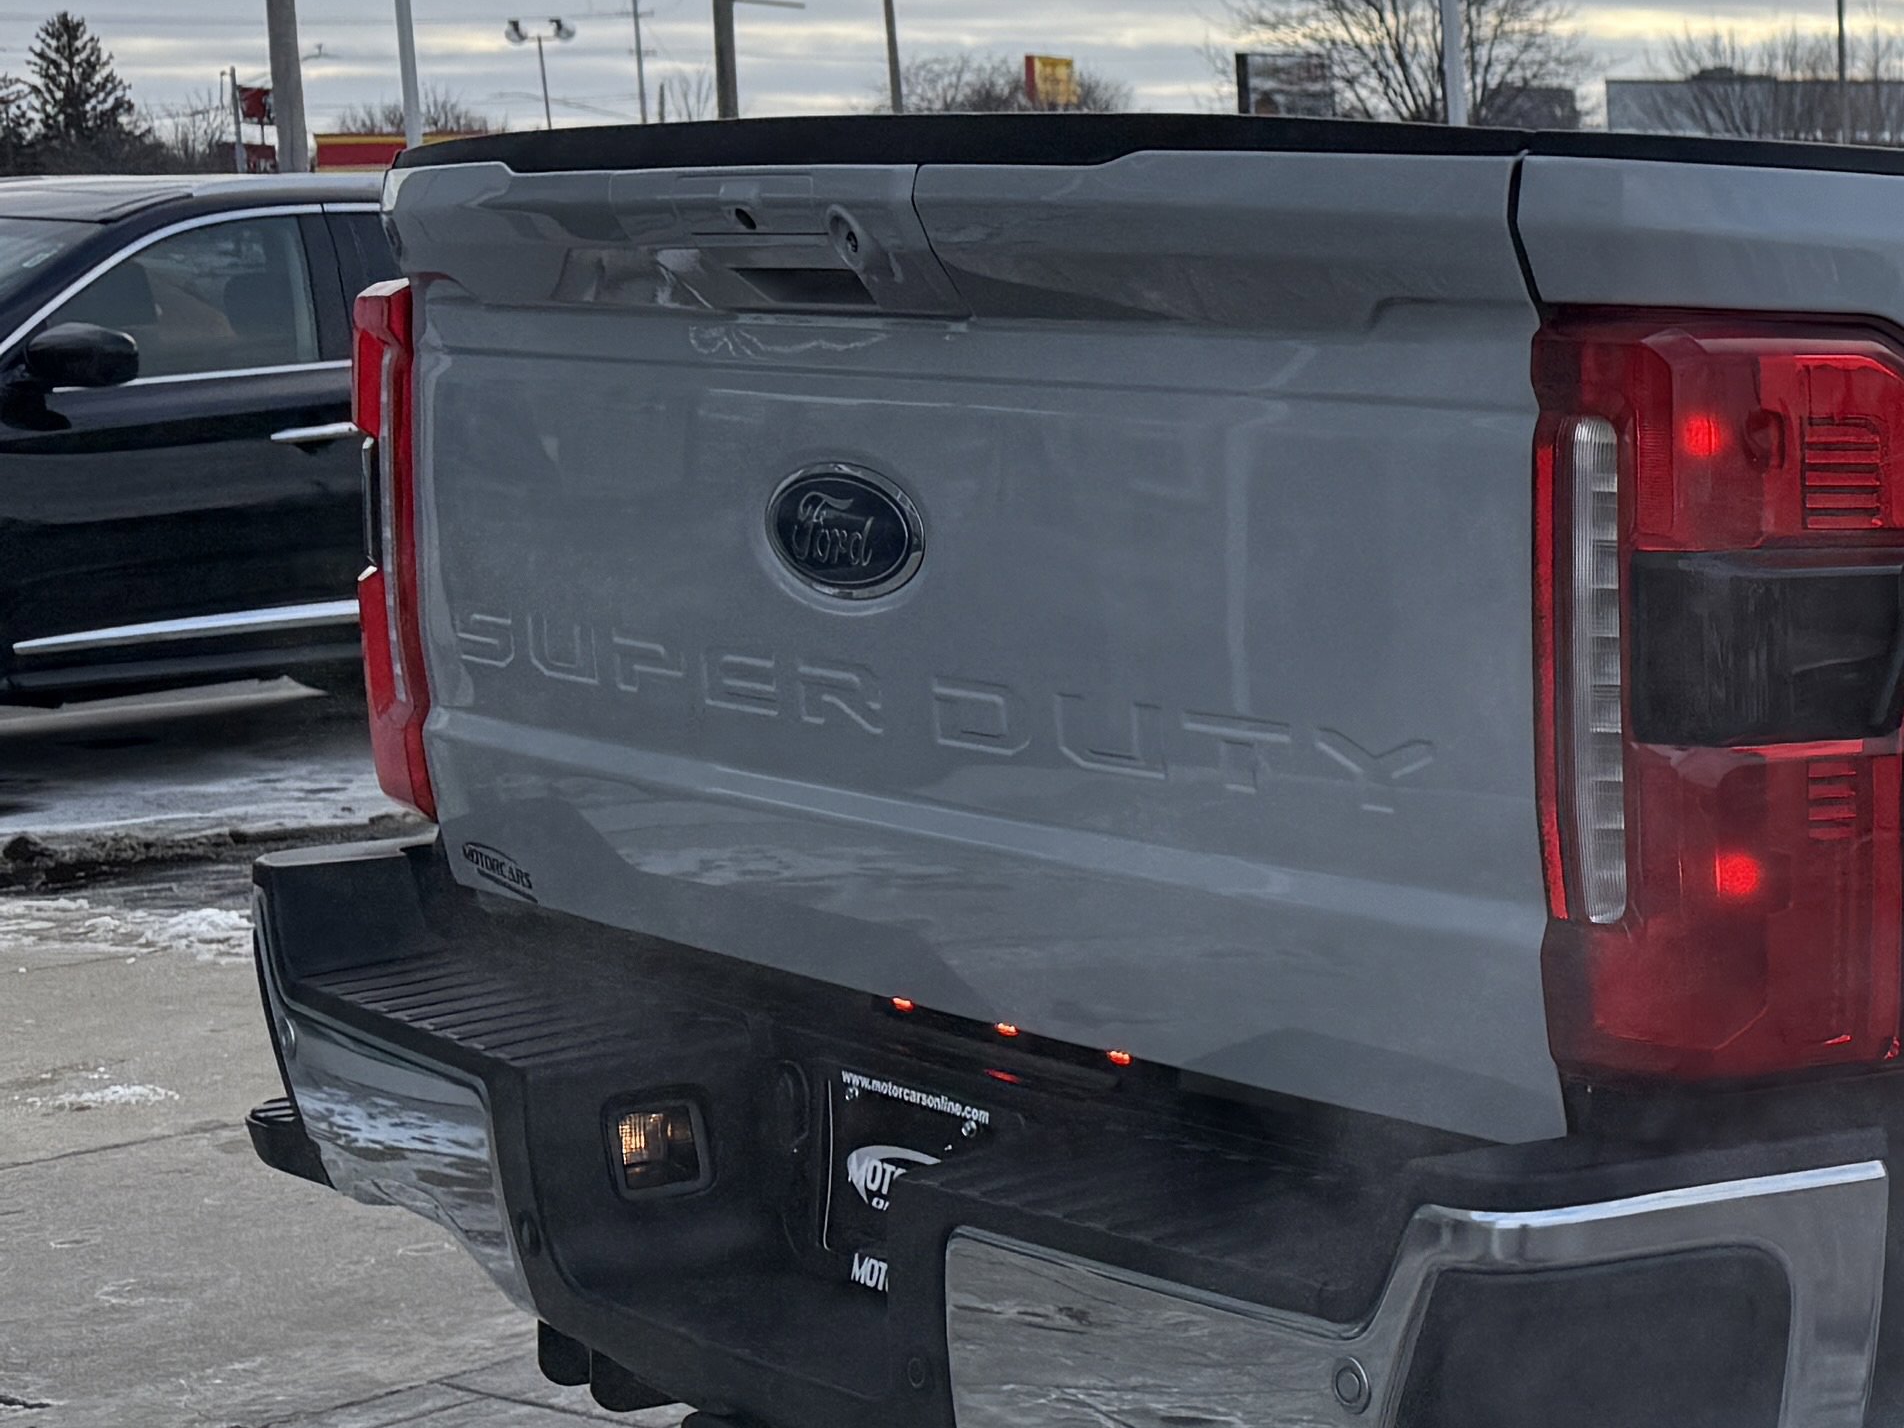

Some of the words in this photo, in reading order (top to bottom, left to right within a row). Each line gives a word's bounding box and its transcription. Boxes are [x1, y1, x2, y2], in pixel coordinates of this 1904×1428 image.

[791, 491, 875, 567] Ford
[455, 610, 885, 736] SUPER
[931, 673, 1436, 814] DUTY
[841, 1070, 990, 1124] www.motorcarsonline.com
[848, 1151, 907, 1195] MOT
[850, 1252, 889, 1293] MOT
